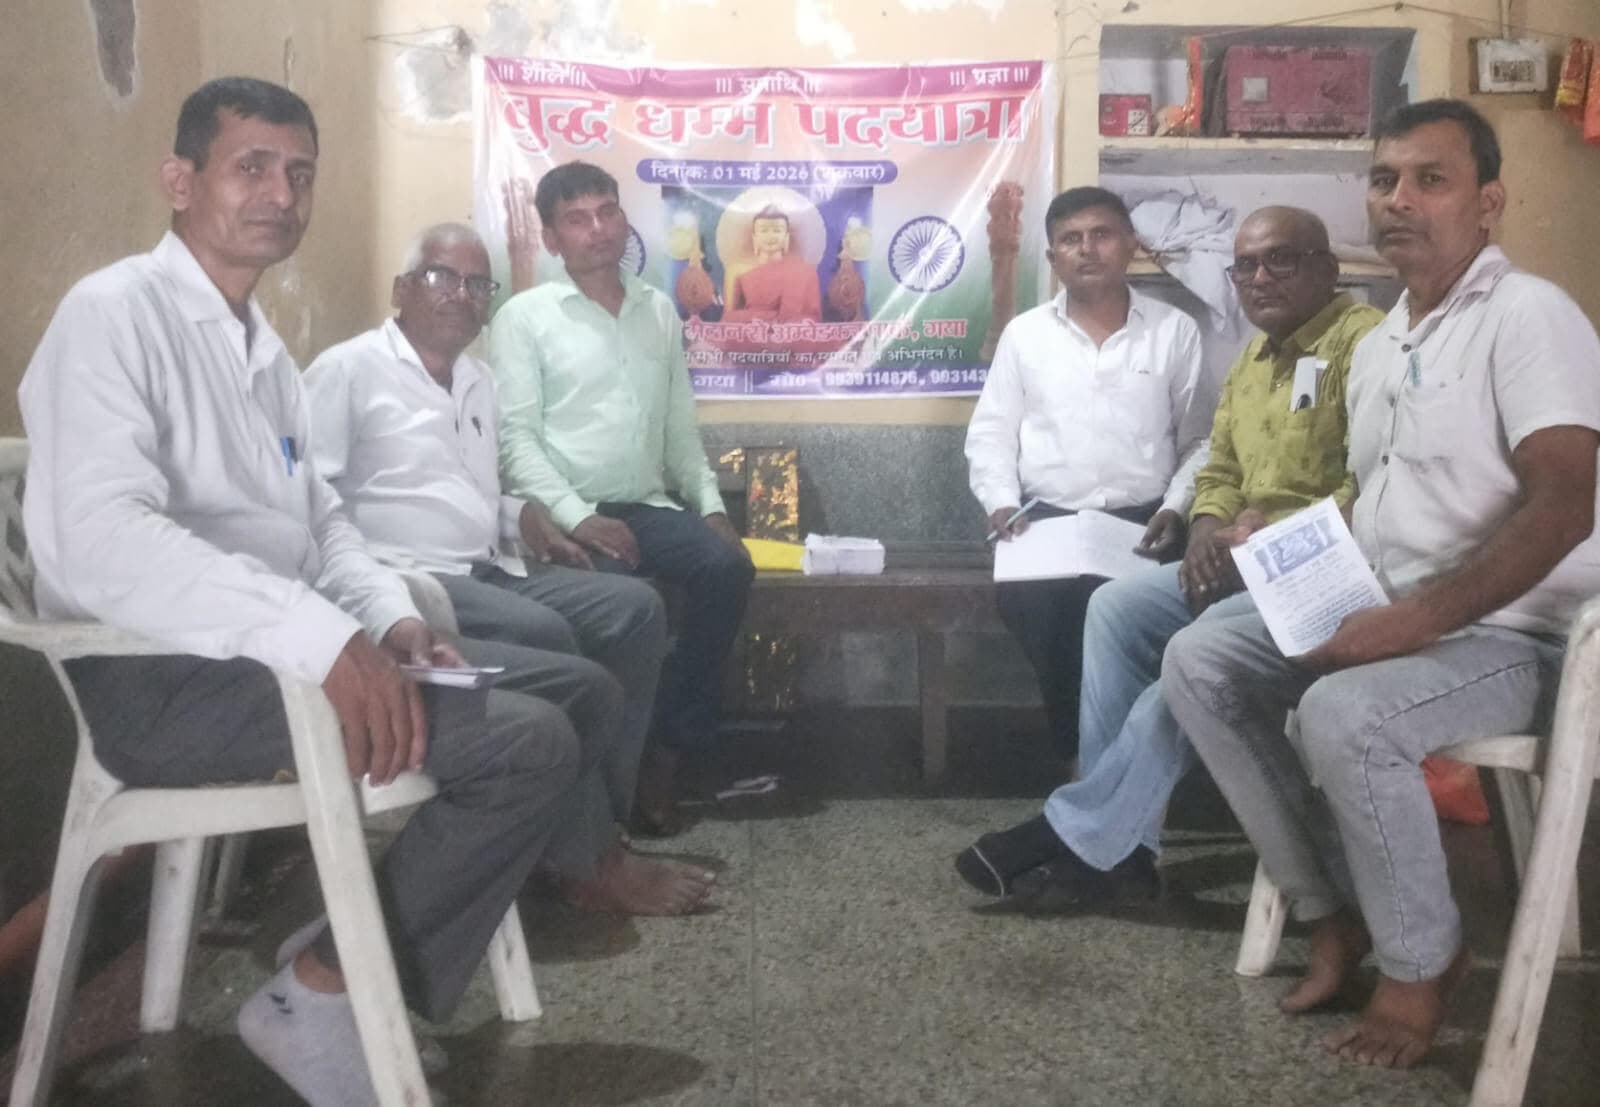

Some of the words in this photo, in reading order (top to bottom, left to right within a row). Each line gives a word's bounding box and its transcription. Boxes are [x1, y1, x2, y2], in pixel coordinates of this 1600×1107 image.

[971, 67, 1010, 85] प्रज्ञा
[503, 93, 612, 152] बुद्ध
[635, 99, 774, 146] धम्म
[794, 96, 1024, 148] पदयात्रा
[713, 168, 733, 180] 01
[738, 162, 761, 181] मई
[766, 167, 808, 181] 2026
[923, 318, 968, 339] गया
[694, 374, 736, 388] गया
